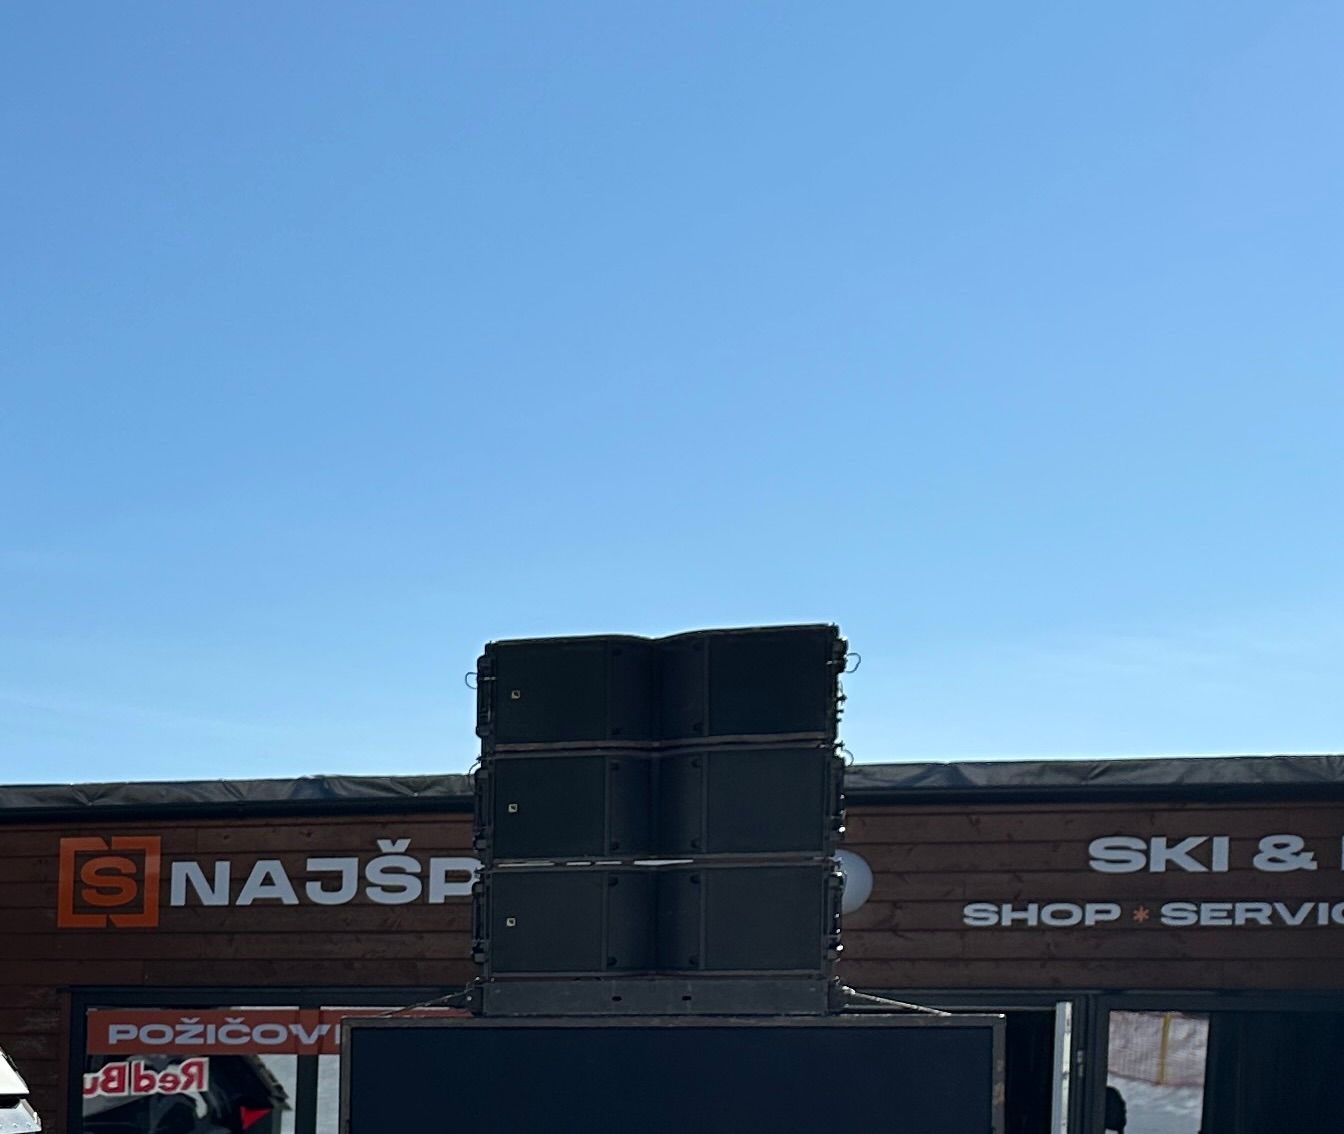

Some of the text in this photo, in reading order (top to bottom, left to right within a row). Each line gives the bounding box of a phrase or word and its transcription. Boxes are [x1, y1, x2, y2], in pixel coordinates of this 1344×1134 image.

[1088, 834, 1319, 873] SKI &
[962, 903, 1122, 927] SHOP
[108, 1017, 340, 1046] POŽIČOV
